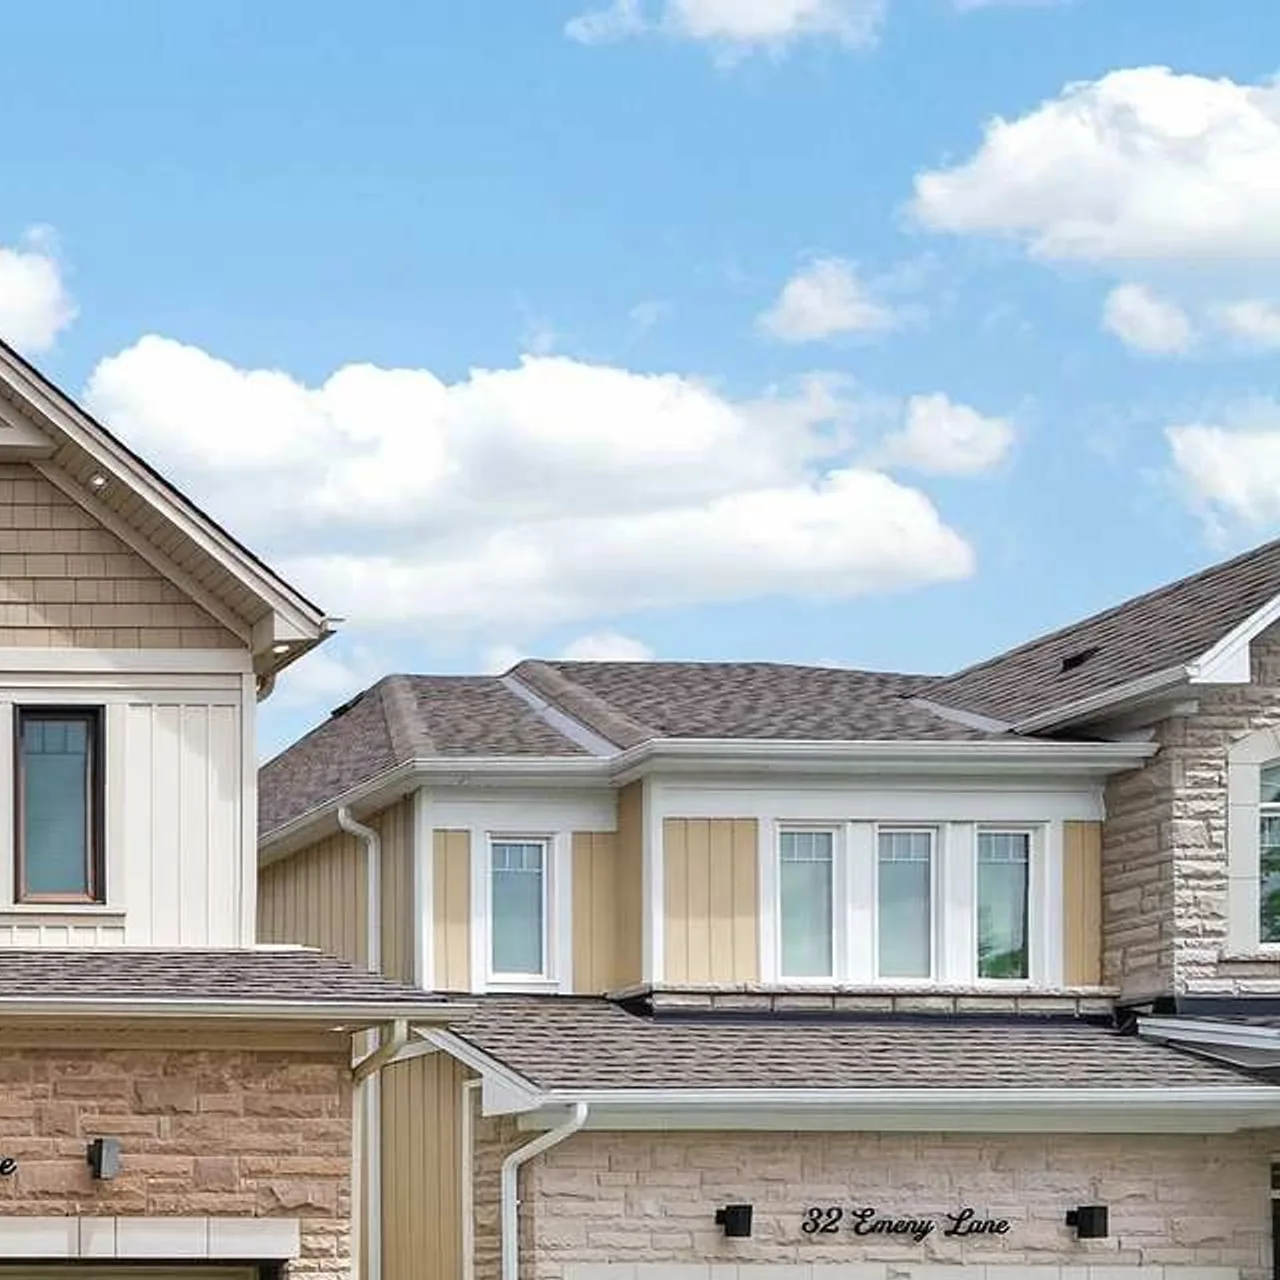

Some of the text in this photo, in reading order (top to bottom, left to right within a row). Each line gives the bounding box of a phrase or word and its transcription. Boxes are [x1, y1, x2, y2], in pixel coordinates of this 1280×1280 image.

[801, 1207, 1011, 1241] 32 Emeny Lane
